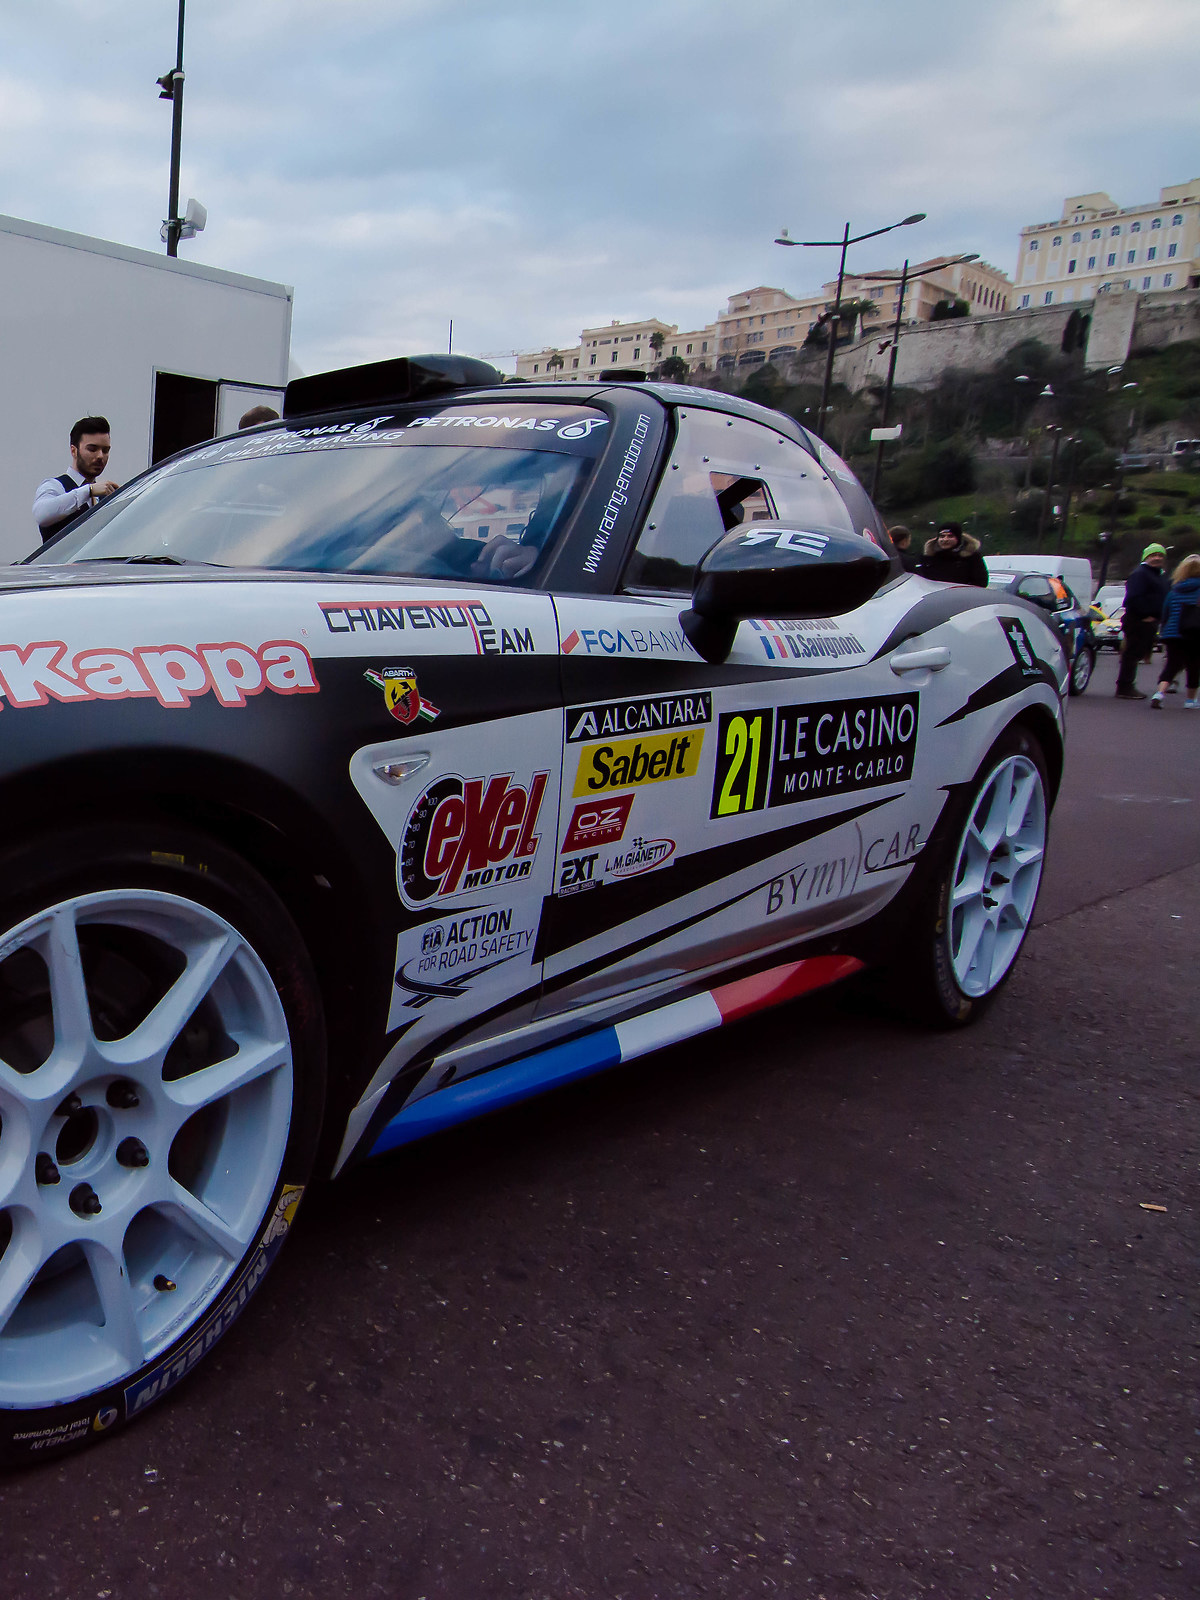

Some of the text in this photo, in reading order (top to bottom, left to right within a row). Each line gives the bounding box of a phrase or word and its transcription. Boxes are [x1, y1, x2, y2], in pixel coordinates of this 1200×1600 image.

[244, 423, 356, 447] PETRONAS
[310, 431, 405, 447] RACING
[407, 416, 560, 431] PETRONAS
[583, 413, 651, 573] www.racing-emotion.com
[785, 633, 866, 659] D.Savignoni
[383, 669, 414, 678] ABARTH
[601, 697, 707, 735] ALCANTARA
[779, 703, 915, 762] LE CASINO
[588, 735, 691, 790] Sabelt
[717, 715, 763, 816] 21
[573, 826, 621, 841] RACING
[462, 860, 532, 889] MOTOR
[560, 852, 599, 886] EXT
[445, 907, 513, 947] ACTION
[417, 929, 535, 974] FOR ROAD SAFETY
[132, 1253, 268, 1411] MICHELIN
